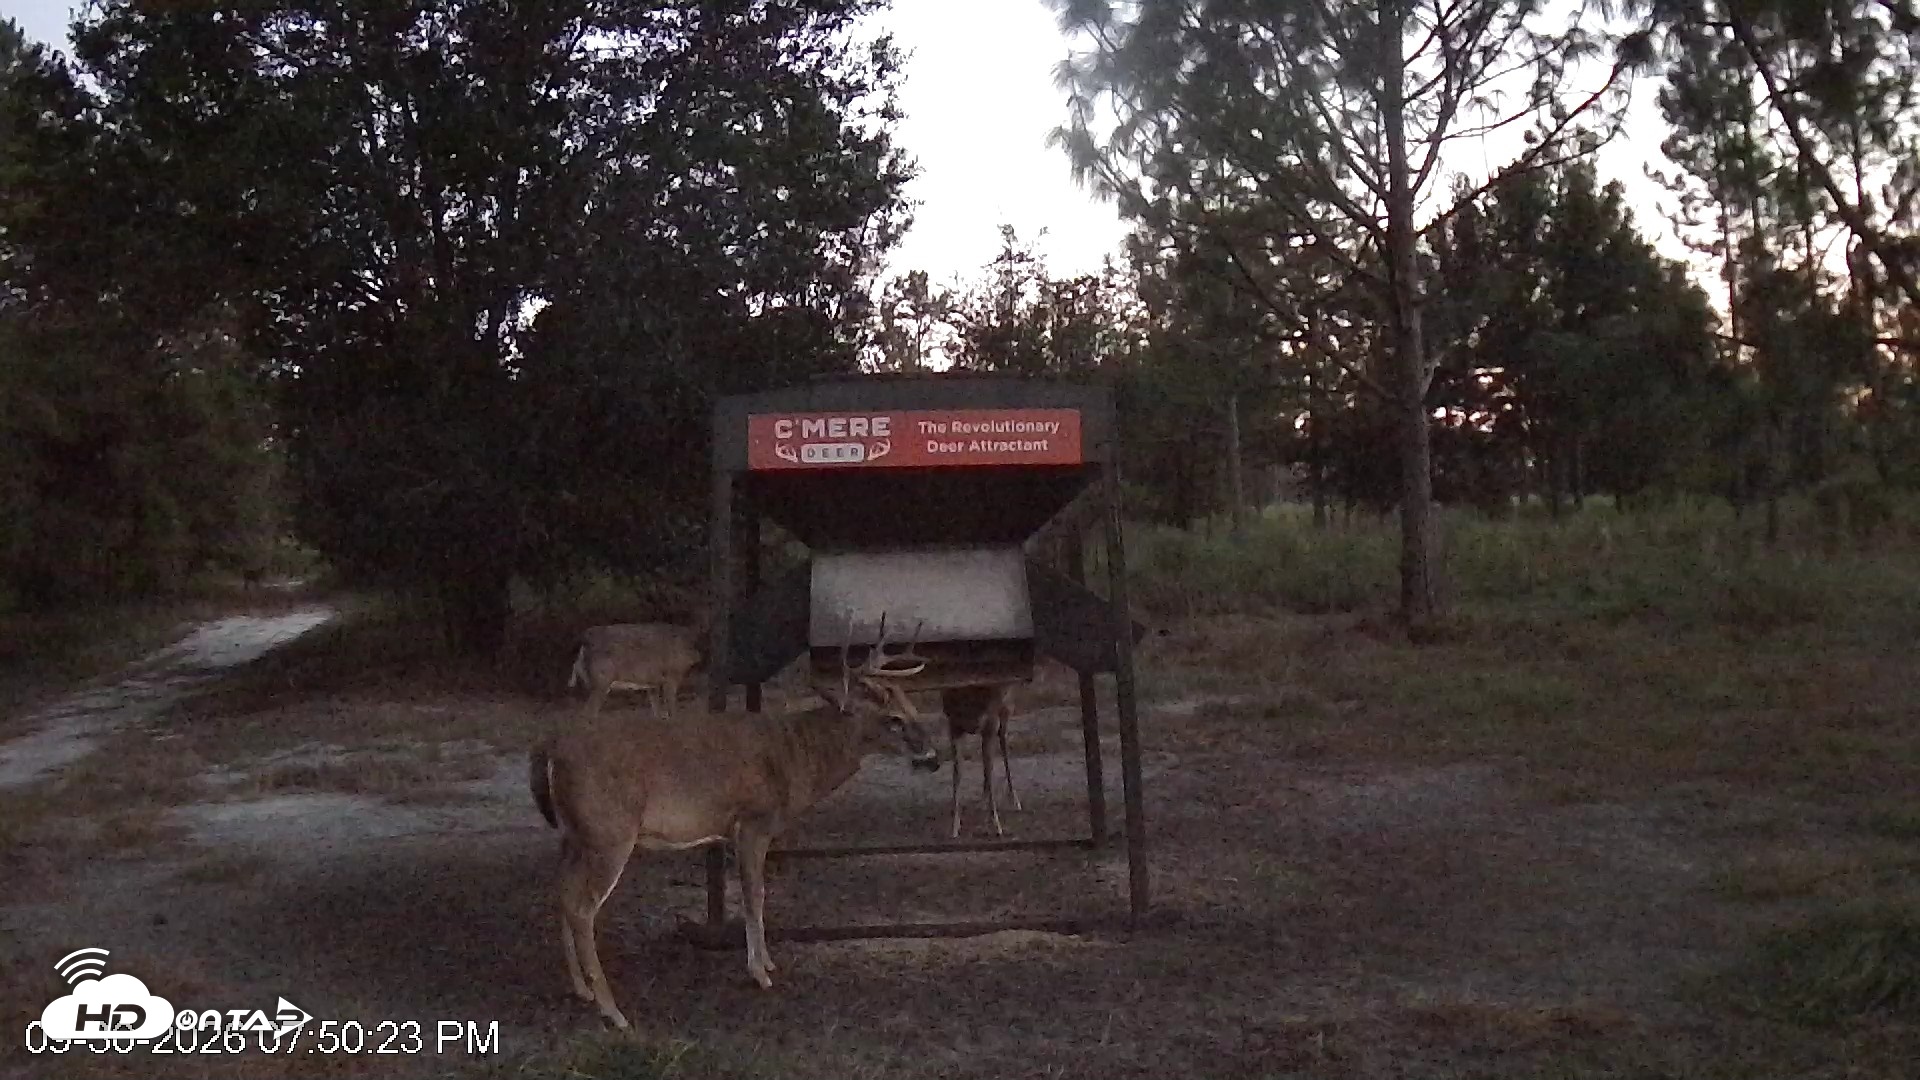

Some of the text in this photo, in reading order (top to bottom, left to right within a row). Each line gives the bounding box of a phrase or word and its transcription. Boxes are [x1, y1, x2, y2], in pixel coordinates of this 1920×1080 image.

[775, 416, 891, 439] C'MERE
[918, 419, 1061, 436] The Revolutionary
[806, 447, 859, 459] DEER
[927, 439, 1049, 453] Deer Attractant
